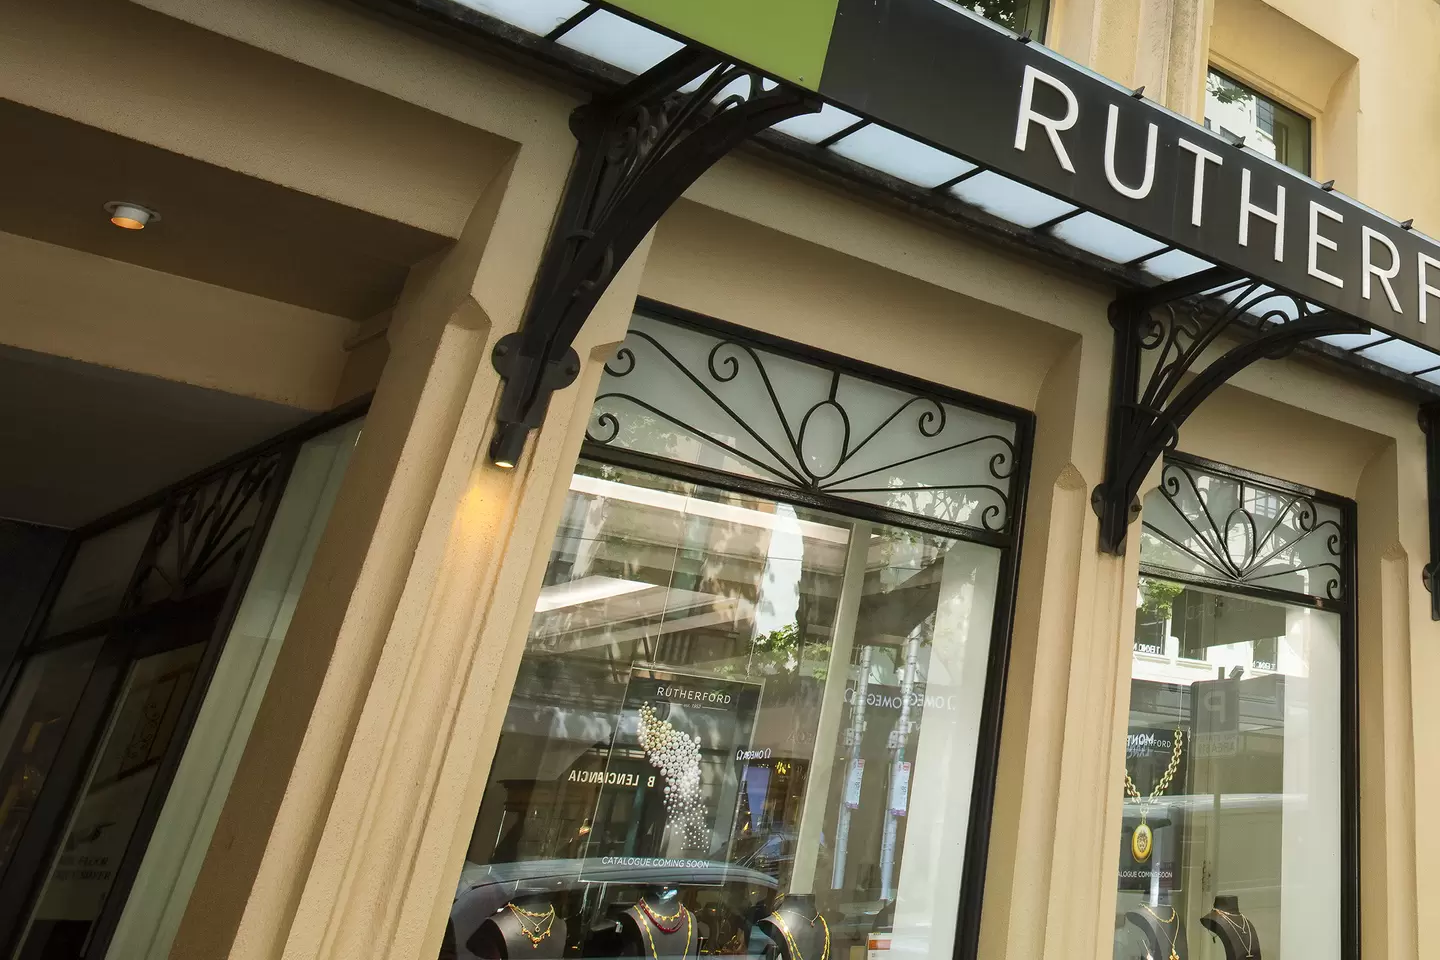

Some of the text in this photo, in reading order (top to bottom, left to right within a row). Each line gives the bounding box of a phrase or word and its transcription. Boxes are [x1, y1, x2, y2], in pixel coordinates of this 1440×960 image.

[656, 686, 732, 704] RUTHERFORD
[601, 856, 710, 869] CATALOGUE COMING SOON
